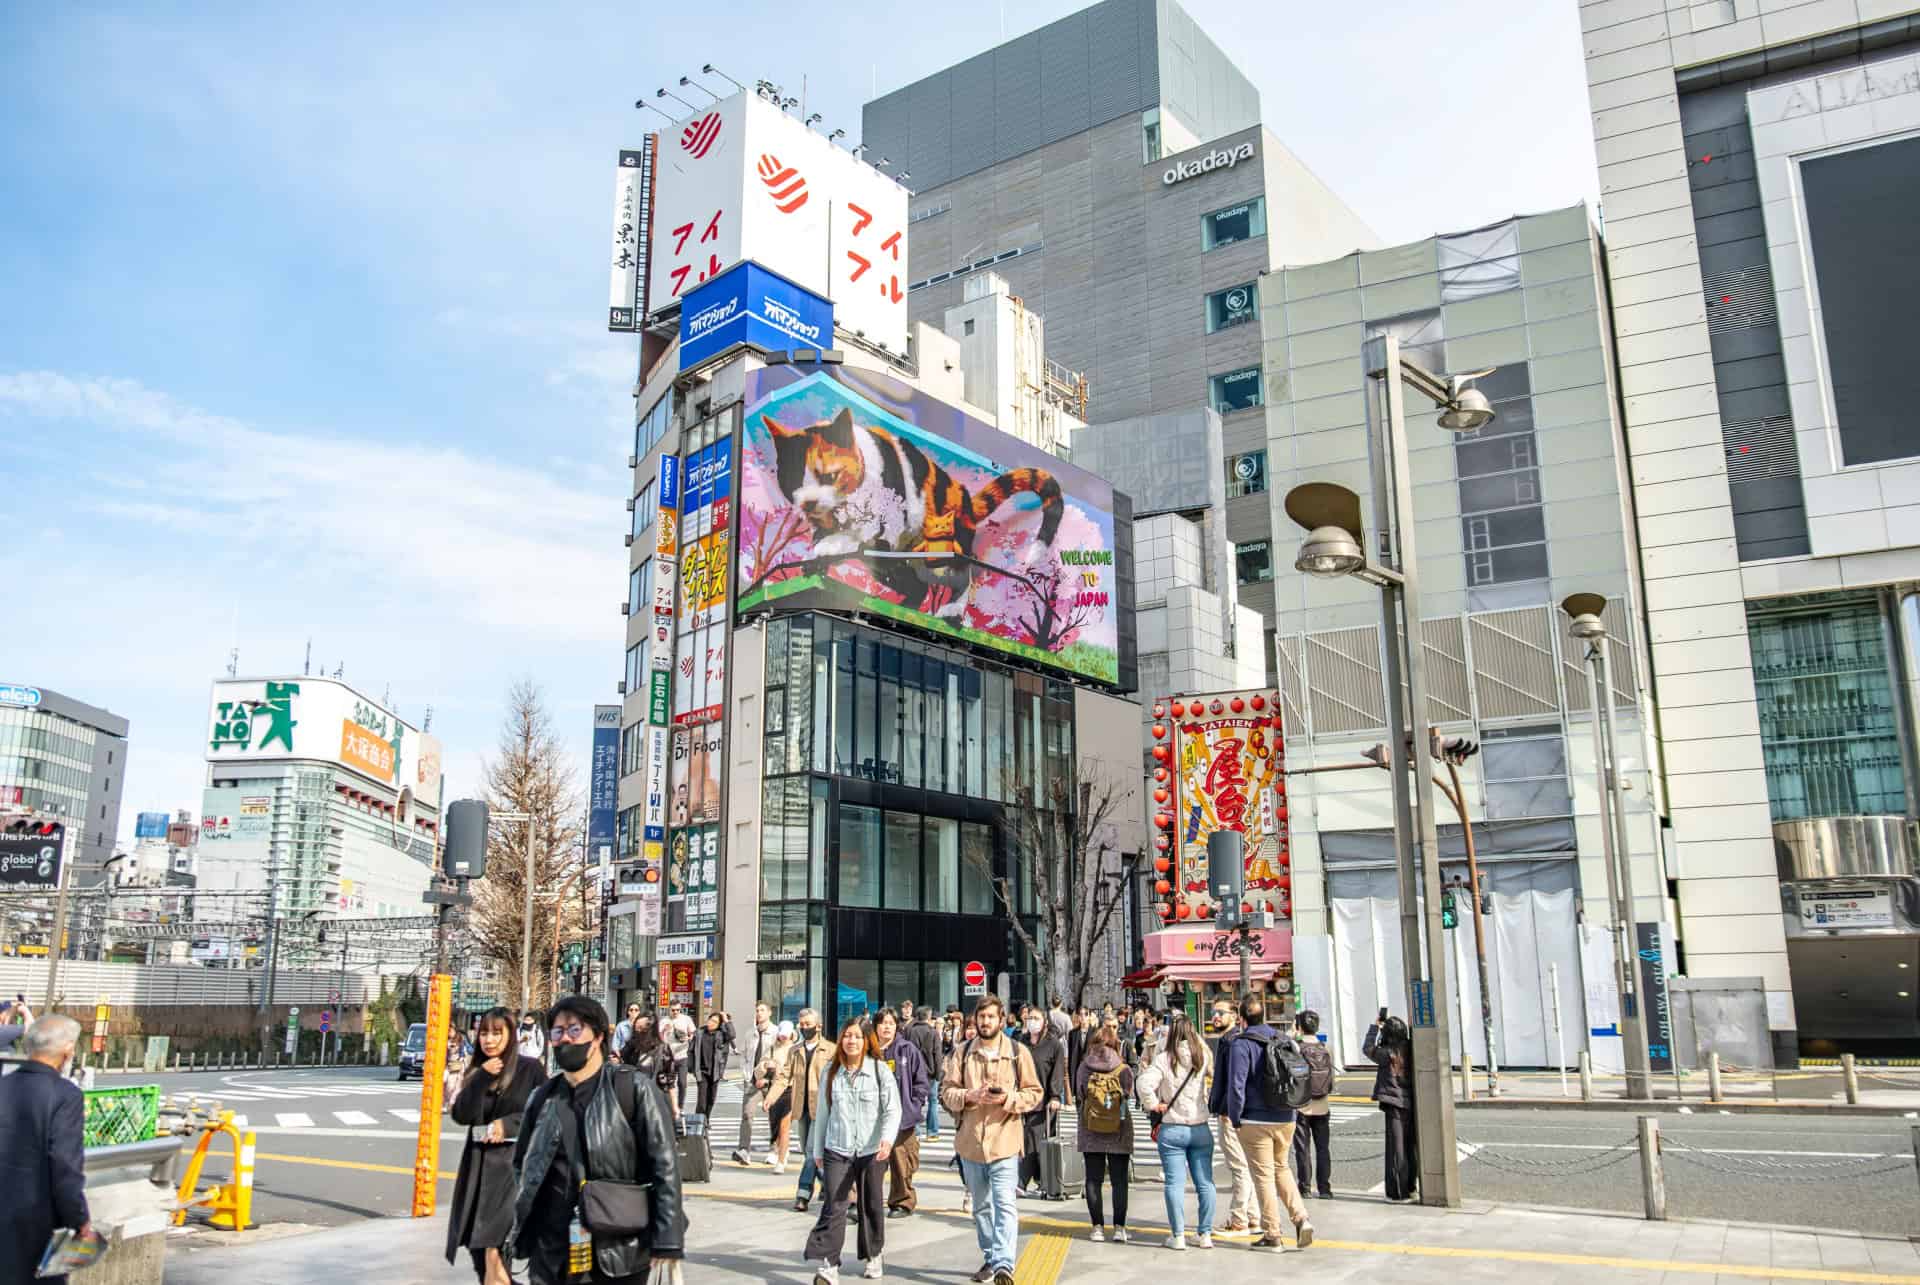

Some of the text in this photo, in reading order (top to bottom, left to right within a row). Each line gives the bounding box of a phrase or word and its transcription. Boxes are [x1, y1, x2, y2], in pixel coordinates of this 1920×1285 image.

[1163, 143, 1255, 186] okadaya
[1216, 206, 1249, 221] okadaya
[689, 297, 738, 336] アパマンショップ
[764, 301, 820, 340] アパマンショップ
[1224, 369, 1258, 384] okadaya
[1060, 550, 1113, 566] WELCOME
[1081, 572, 1097, 587] TO
[1074, 591, 1109, 608] JAPAN
[1200, 719, 1254, 732] YATAIEN
[650, 828, 660, 838] 1F
[1, 853, 38, 873] global
